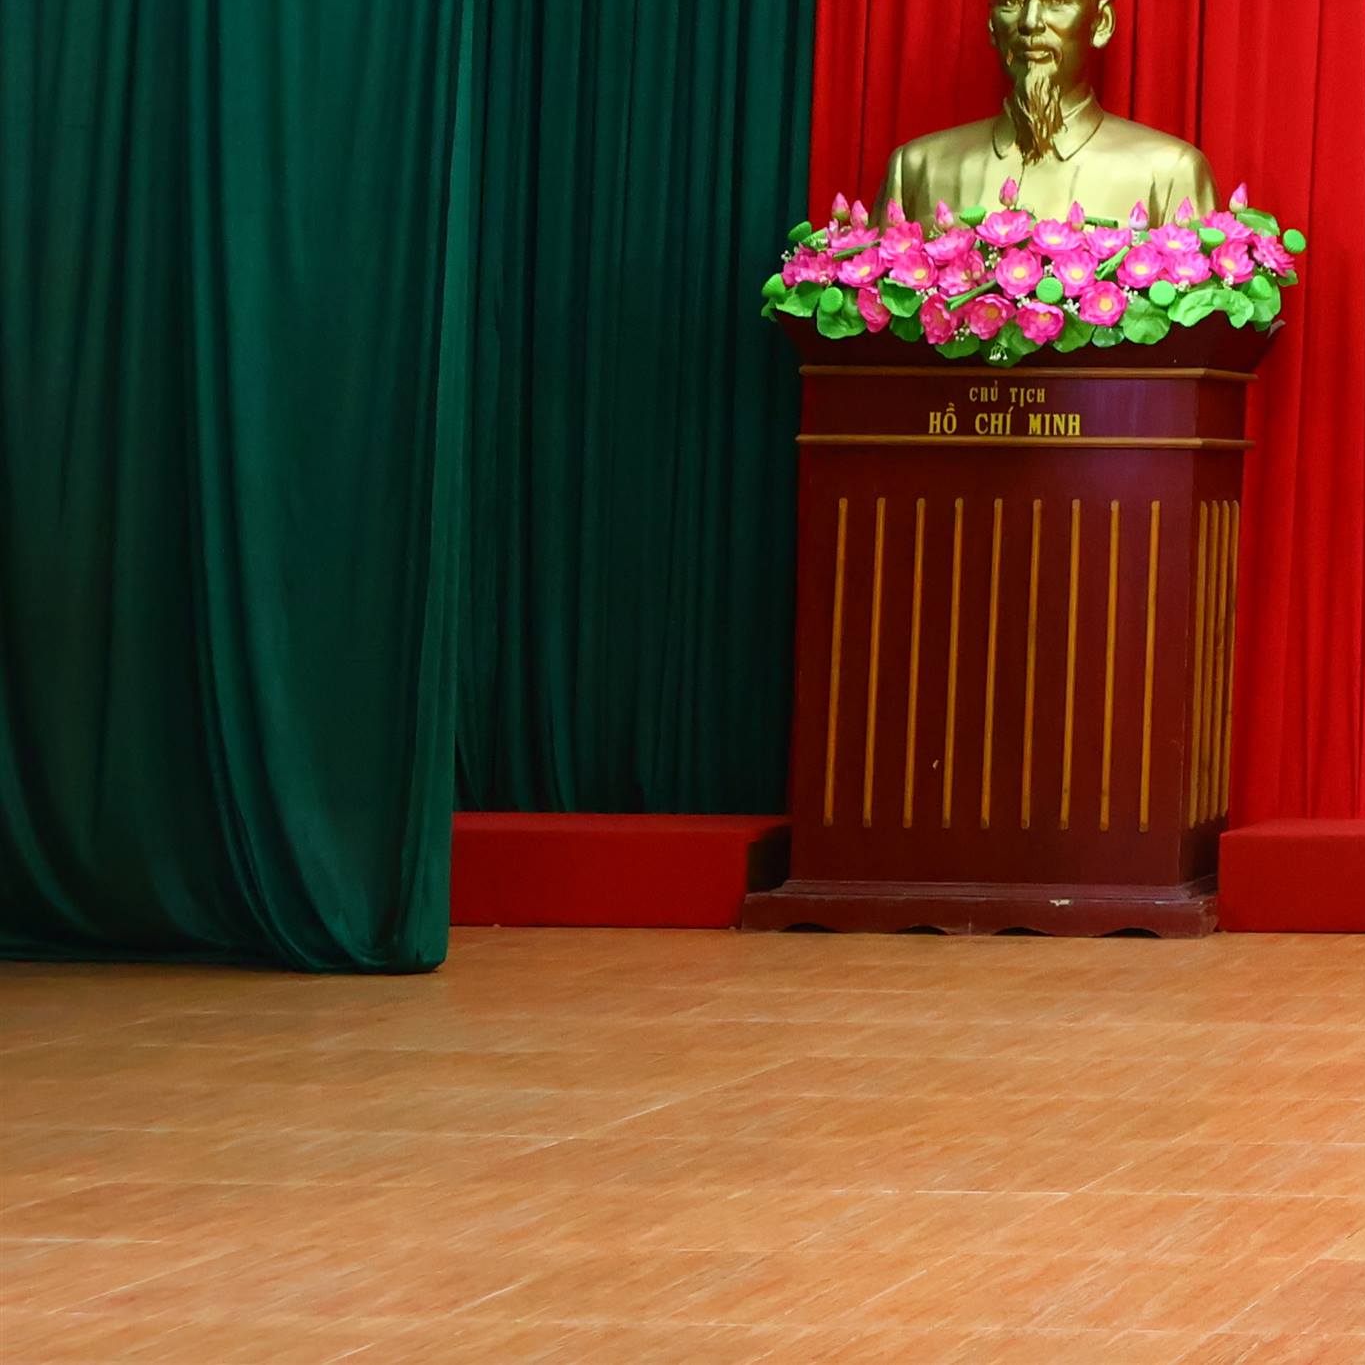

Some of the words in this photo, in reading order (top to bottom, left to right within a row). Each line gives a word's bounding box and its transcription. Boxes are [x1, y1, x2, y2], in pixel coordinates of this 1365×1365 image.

[1009, 387, 1046, 407] TỊCH
[928, 402, 957, 434] HỒ
[974, 406, 1014, 435] CHÍ
[1028, 413, 1081, 436] MINH
